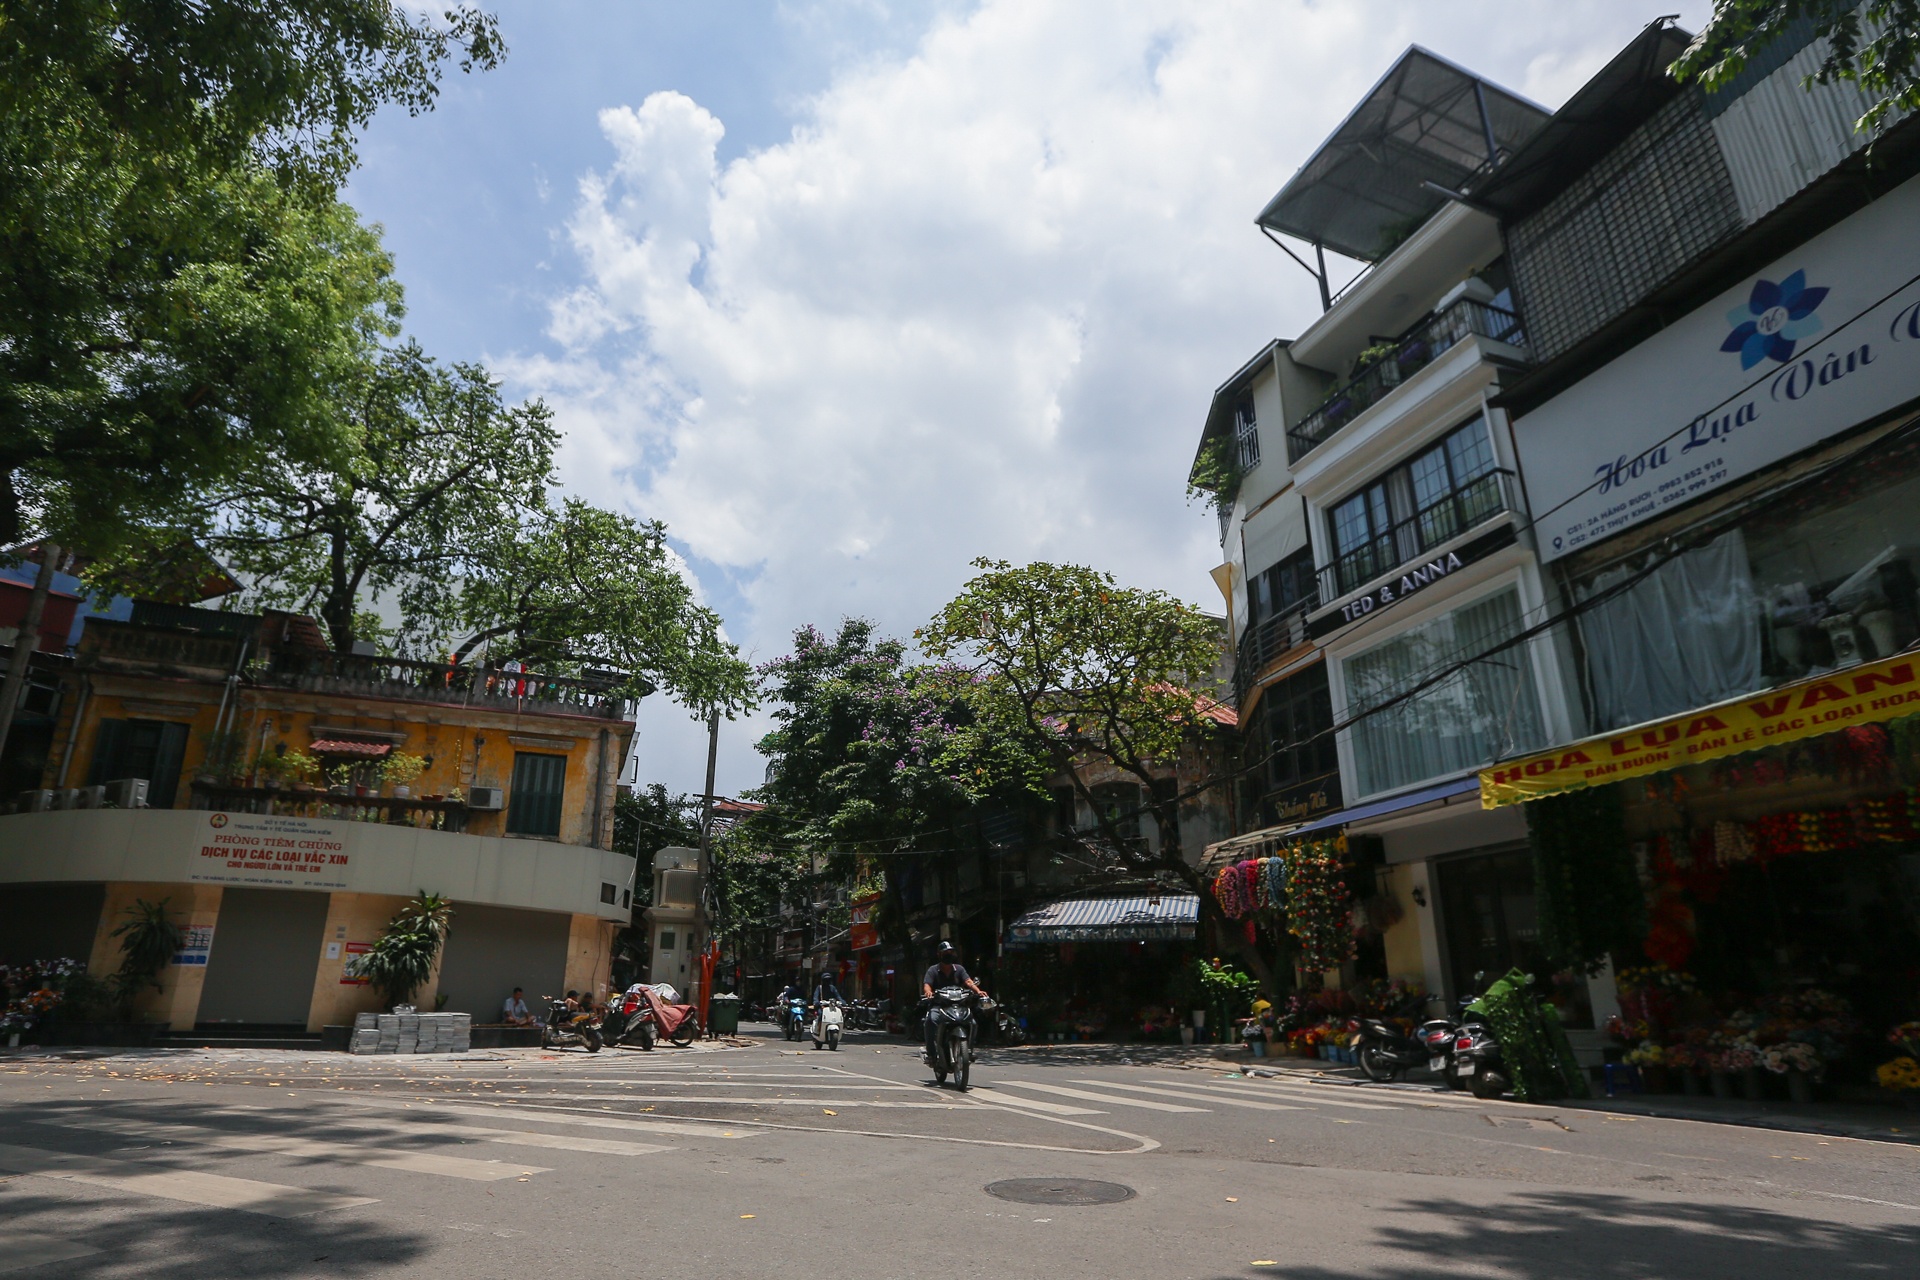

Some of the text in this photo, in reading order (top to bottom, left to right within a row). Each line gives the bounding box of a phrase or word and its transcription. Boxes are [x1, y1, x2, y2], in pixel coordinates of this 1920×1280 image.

[1594, 343, 1877, 495] Hoa Lụa Vân
[1588, 515, 1600, 527] 2A
[1601, 501, 1627, 519] HÀNG
[1590, 525, 1606, 538] 472
[1607, 514, 1630, 530] THỤY
[1341, 552, 1463, 622] TED & ANNA
[1492, 662, 1916, 786] HOA LỤA VÂN
[1584, 763, 1618, 779] BÁN
[1622, 750, 1670, 772] BUÔN
[1687, 735, 1728, 756] BÁN
[1733, 727, 1756, 746] LẺ
[1761, 716, 1805, 738] CÁC
[1812, 703, 1864, 725] LOẠI
[1871, 690, 1920, 710] HOA
[201, 846, 349, 865] DỊCH VỤ CÁC LOẠI VẮC XIN
[214, 834, 342, 851] PHÒNG TIÊM CHỦNG
[227, 860, 242, 869] CHO
[283, 862, 293, 872] VÀ
[310, 865, 321, 873] EM
